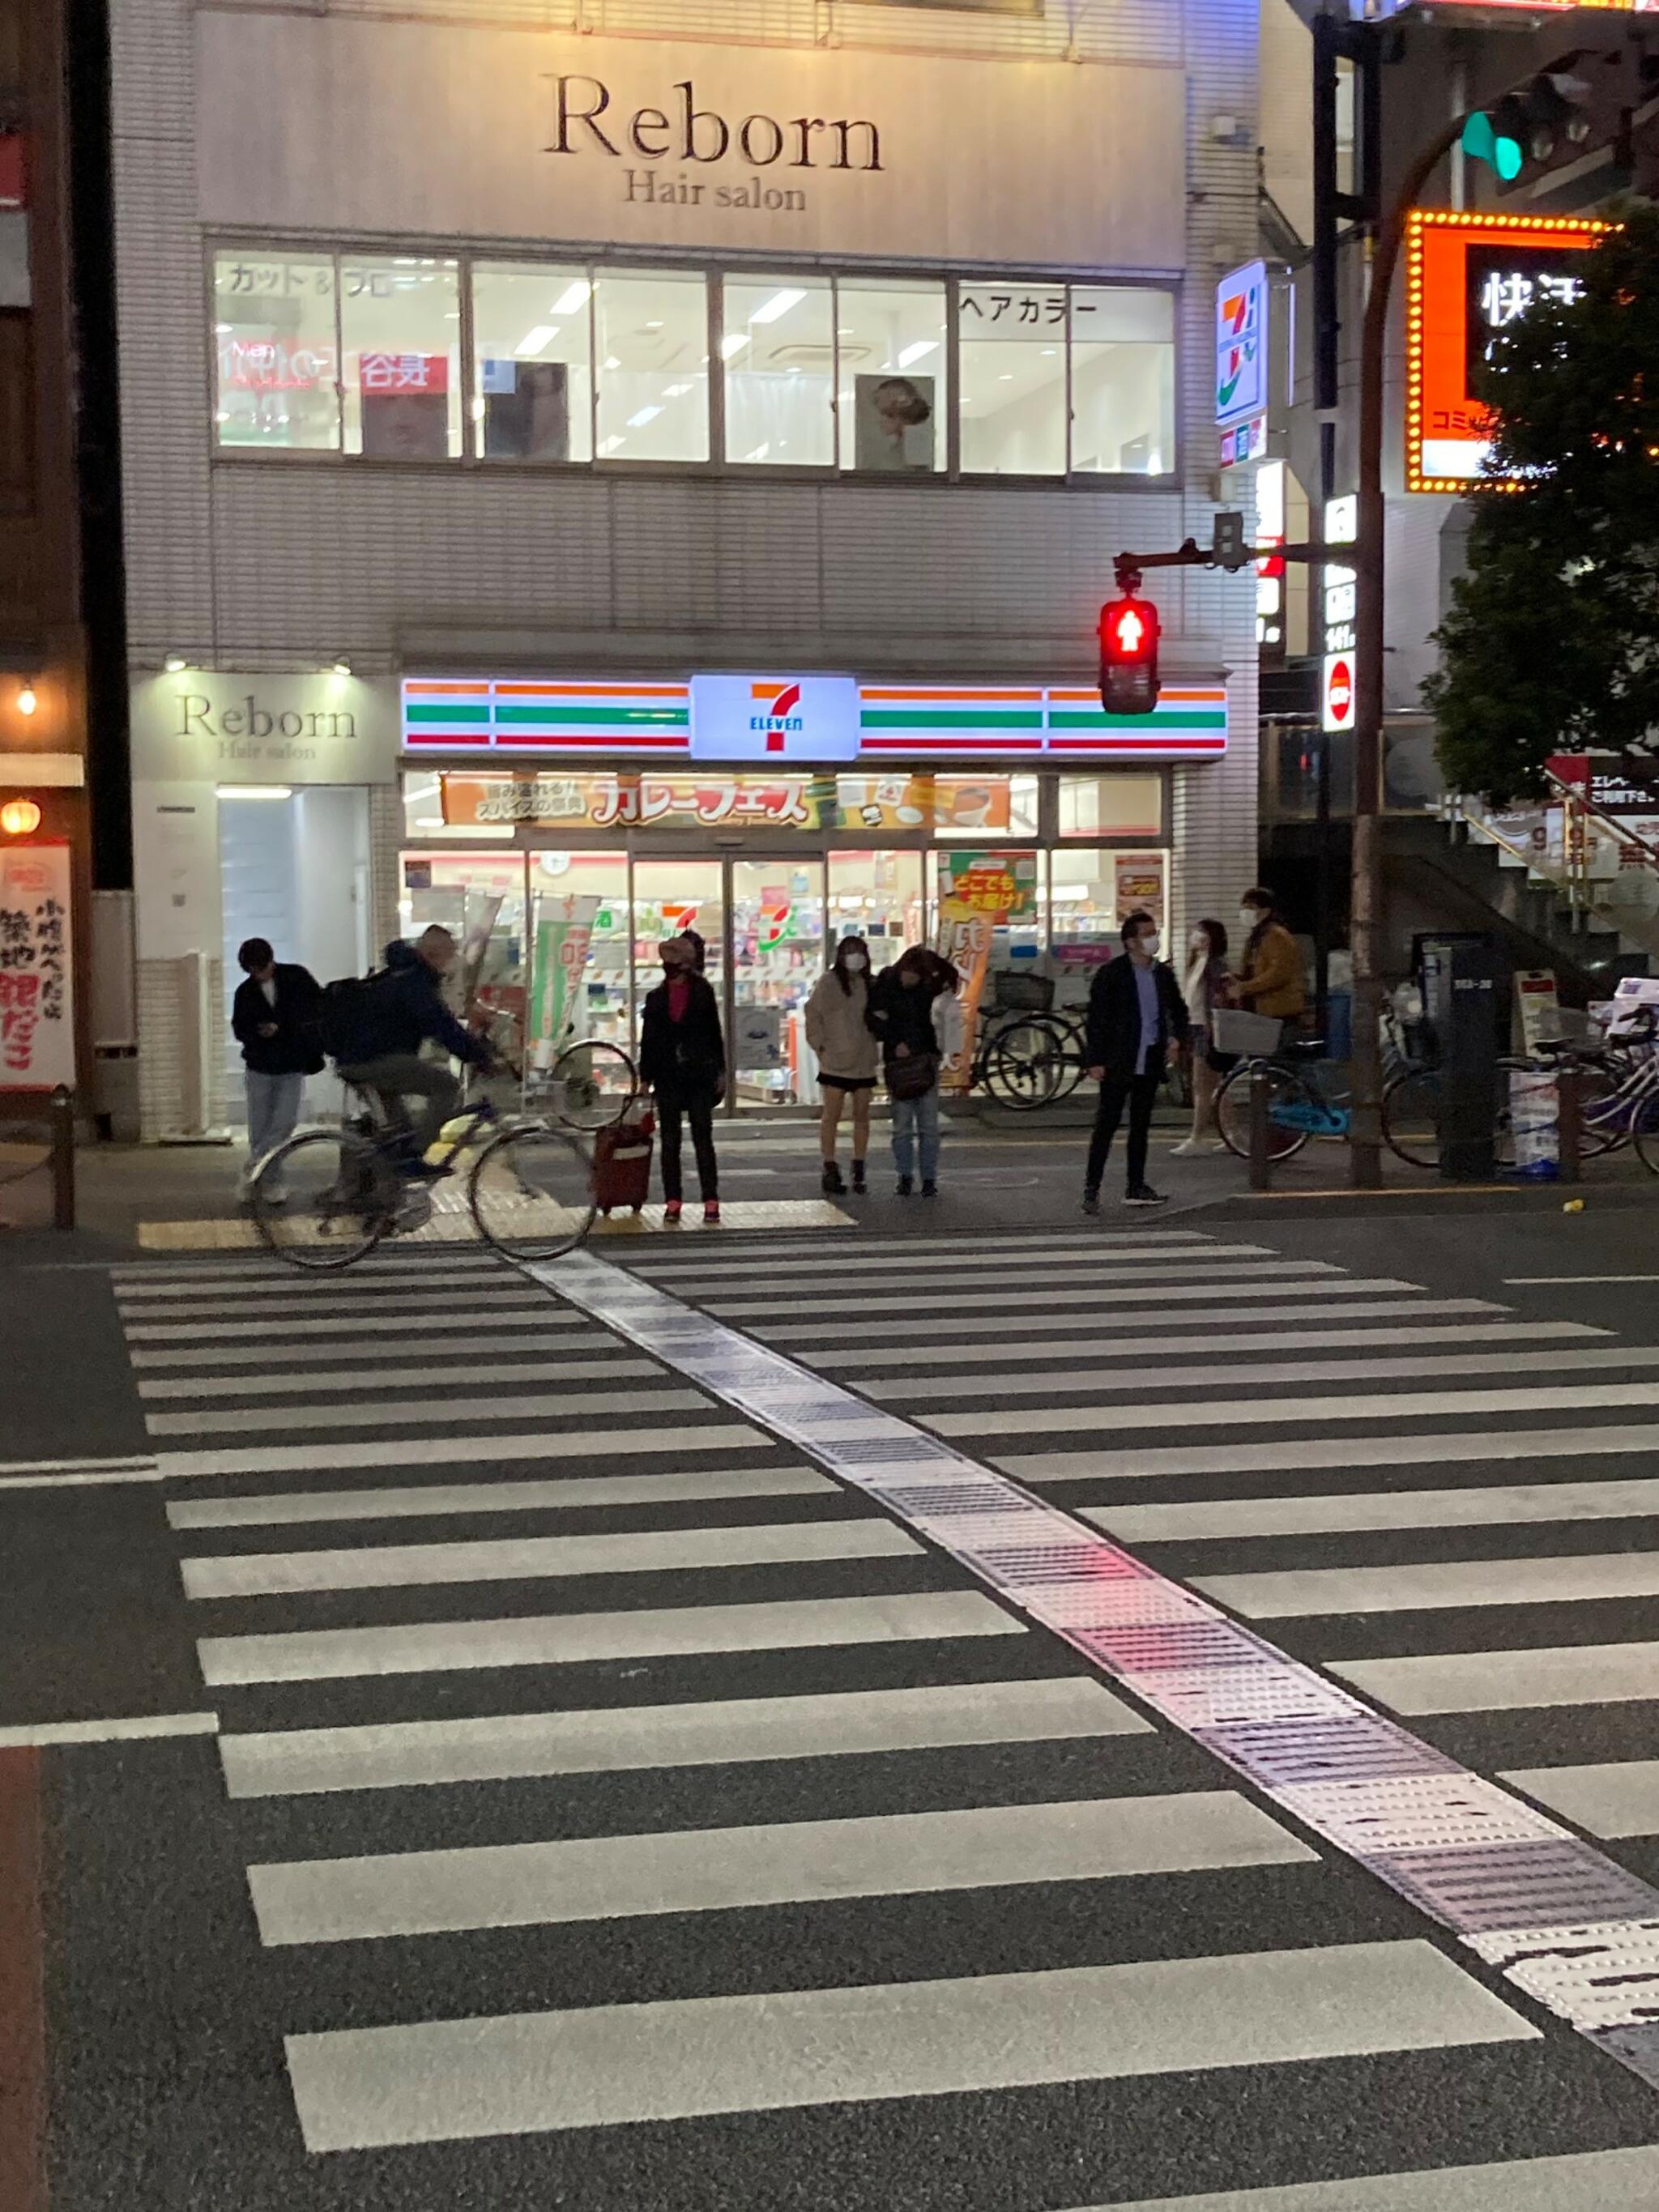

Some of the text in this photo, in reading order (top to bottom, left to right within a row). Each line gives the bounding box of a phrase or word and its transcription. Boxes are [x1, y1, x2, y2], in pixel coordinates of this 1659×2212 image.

[541, 73, 885, 172] Reborn
[622, 168, 808, 212] Hair salon
[959, 296, 1096, 323] ヘアカラー
[175, 694, 357, 738] Reborn
[219, 740, 316, 760] Hair salon
[591, 779, 808, 823] カレーフェス
[954, 874, 1015, 891] どこでも
[967, 891, 1025, 911] お届け!
